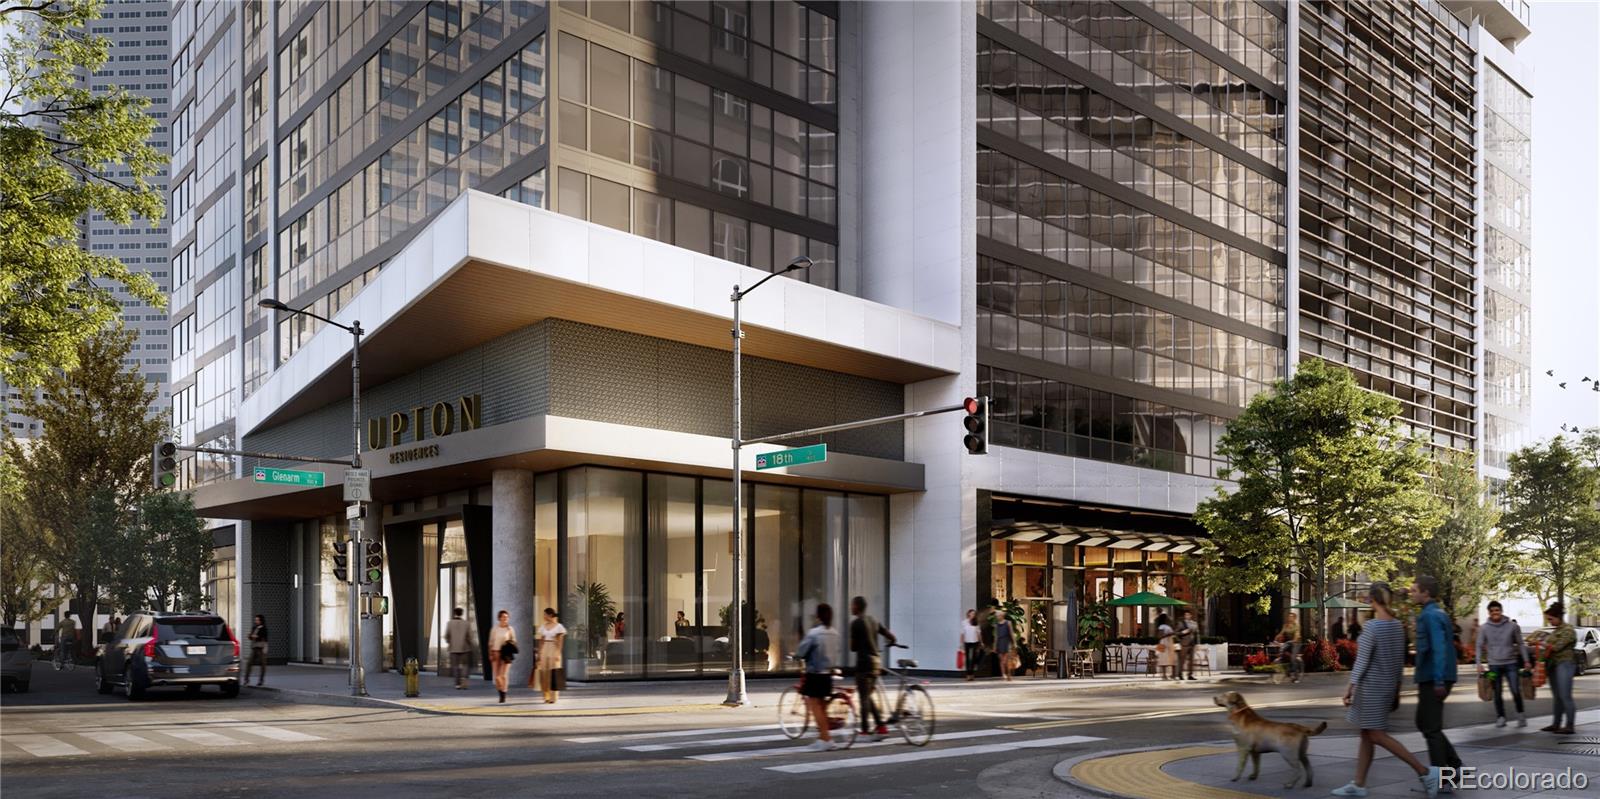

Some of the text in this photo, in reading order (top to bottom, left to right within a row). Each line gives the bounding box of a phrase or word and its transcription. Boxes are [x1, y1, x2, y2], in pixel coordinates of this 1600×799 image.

[368, 393, 481, 452] UPTON
[389, 444, 440, 464] RESIDENCES
[772, 453, 793, 465] 18th
[272, 470, 300, 483] Glenarm
